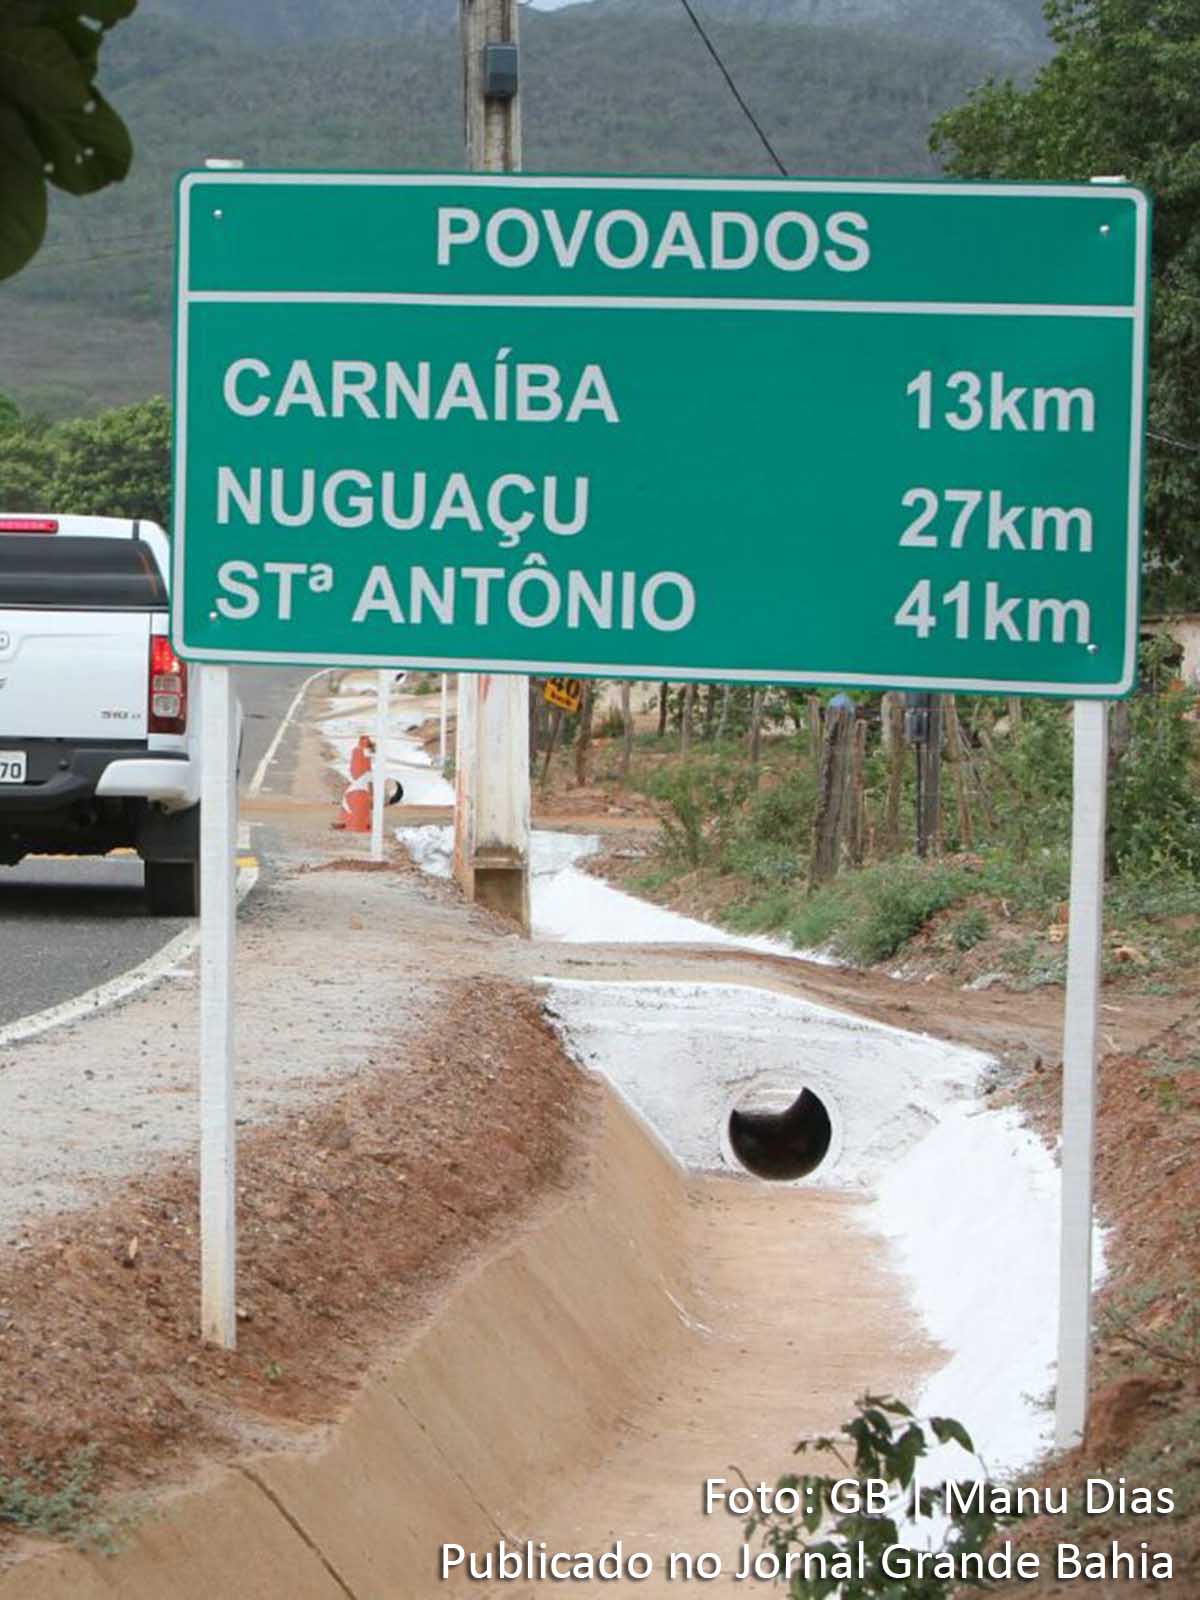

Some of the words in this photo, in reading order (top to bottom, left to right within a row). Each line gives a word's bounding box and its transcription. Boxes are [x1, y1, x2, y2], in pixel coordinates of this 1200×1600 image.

[437, 206, 871, 271] POVOADOS
[223, 347, 619, 423] CARNAÍBA
[905, 369, 1095, 432] 13km
[217, 466, 589, 548] NUGUAÇU
[899, 487, 1093, 553] 27km
[352, 551, 696, 631] ANTÔNIO
[894, 579, 1091, 644] 41km
